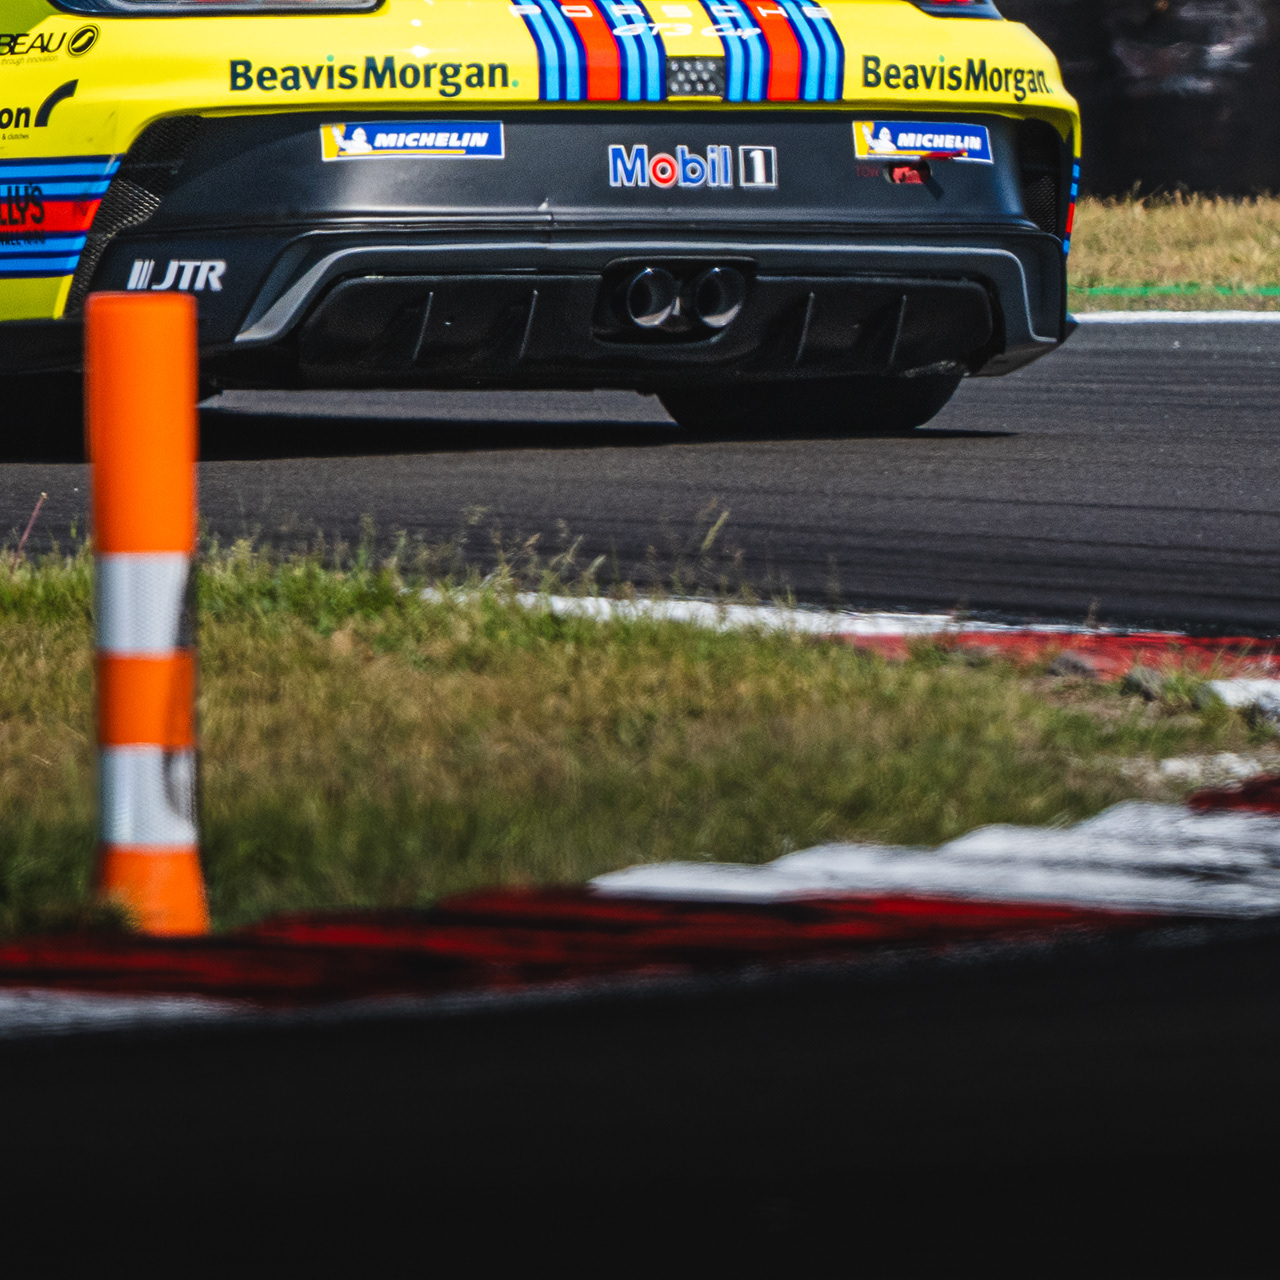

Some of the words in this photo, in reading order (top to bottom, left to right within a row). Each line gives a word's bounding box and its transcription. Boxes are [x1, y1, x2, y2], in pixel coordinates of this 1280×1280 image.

[508, 4, 833, 18] PORSCHE
[700, 23, 762, 39] Cup
[0, 56, 25, 66] through
[2, 133, 7, 141] &
[7, 132, 30, 141] clutches
[373, 132, 489, 148] MICHELIN
[897, 132, 982, 150] MICHELIN
[608, 144, 733, 189] Mobil
[151, 259, 228, 291] JTR
